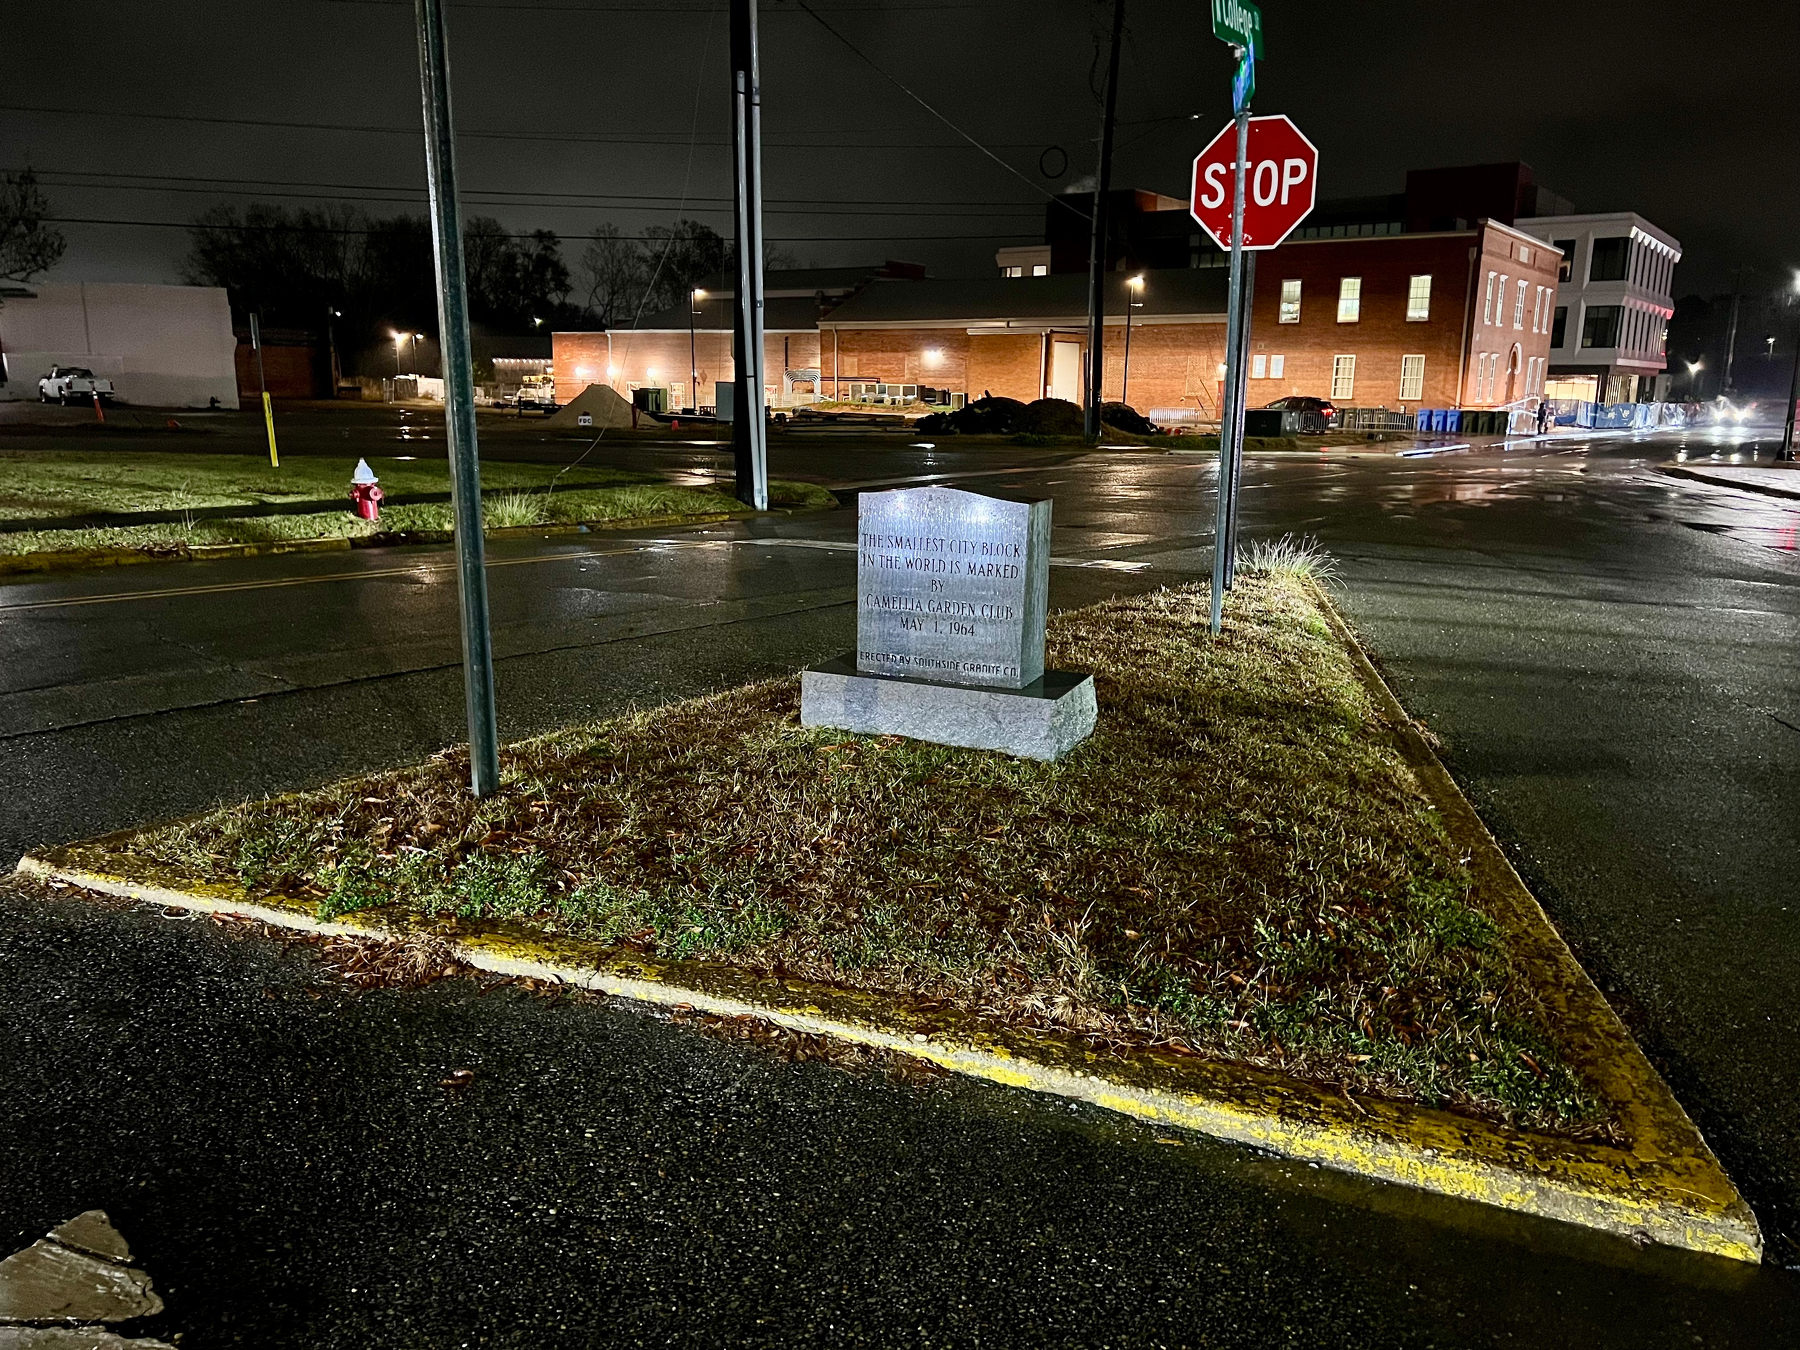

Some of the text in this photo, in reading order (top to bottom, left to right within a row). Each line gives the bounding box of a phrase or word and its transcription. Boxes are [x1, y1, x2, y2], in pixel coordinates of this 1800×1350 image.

[1201, 158, 1308, 209] SOP
[862, 533, 1021, 558] THE SMALLEST CITY BLOCK
[862, 553, 1019, 579] IN THE WORLD IS MARKED
[931, 579, 946, 593] BY
[866, 593, 1013, 620] CAMELLIA GARDEN CLUB
[900, 616, 924, 631] MAY
[949, 621, 975, 637] 1964
[860, 651, 897, 663] ERECTED
[899, 655, 911, 665] BY
[914, 656, 960, 671] SOUTHSIDE
[963, 662, 1001, 676] GRANITE
